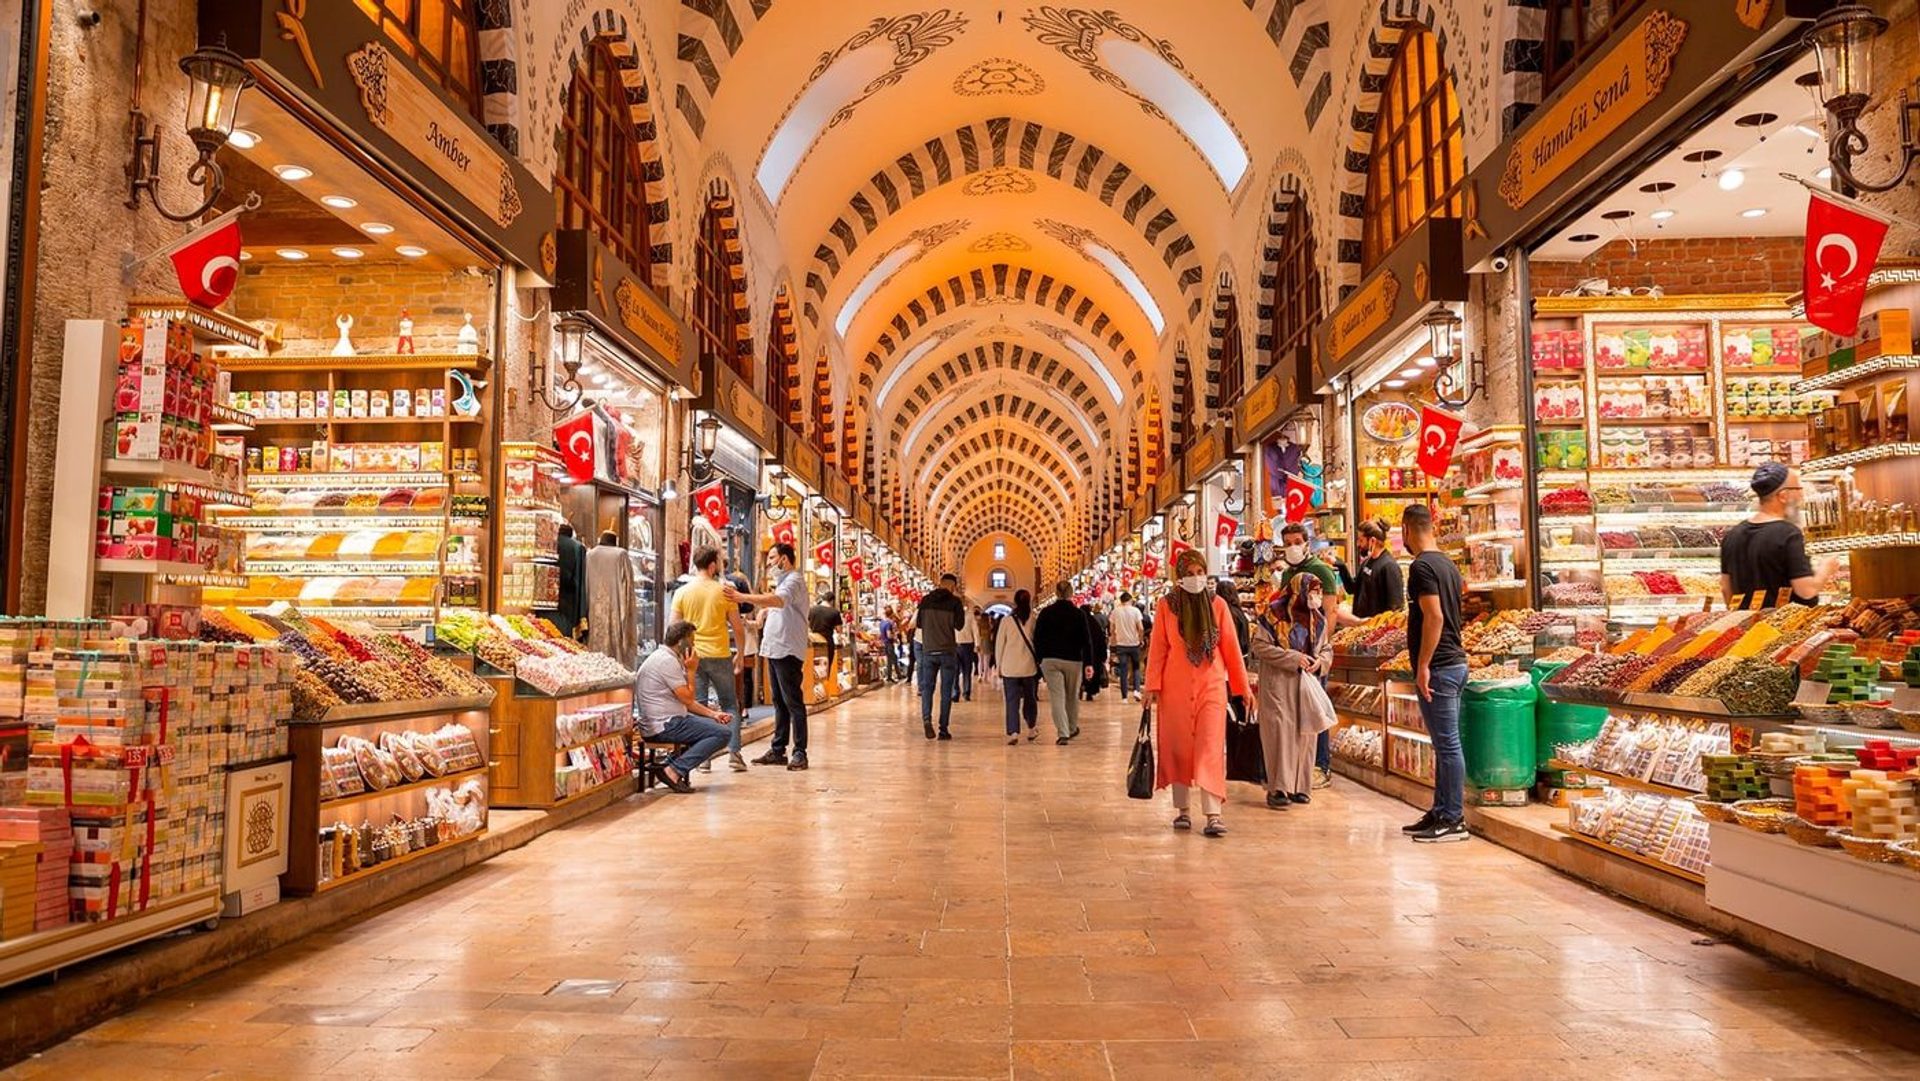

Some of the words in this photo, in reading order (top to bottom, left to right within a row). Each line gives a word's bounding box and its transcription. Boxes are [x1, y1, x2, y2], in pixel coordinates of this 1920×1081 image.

[426, 121, 471, 172] Amber
[1531, 102, 1588, 174] Hamd-ü
[1592, 63, 1630, 121] Senâ
